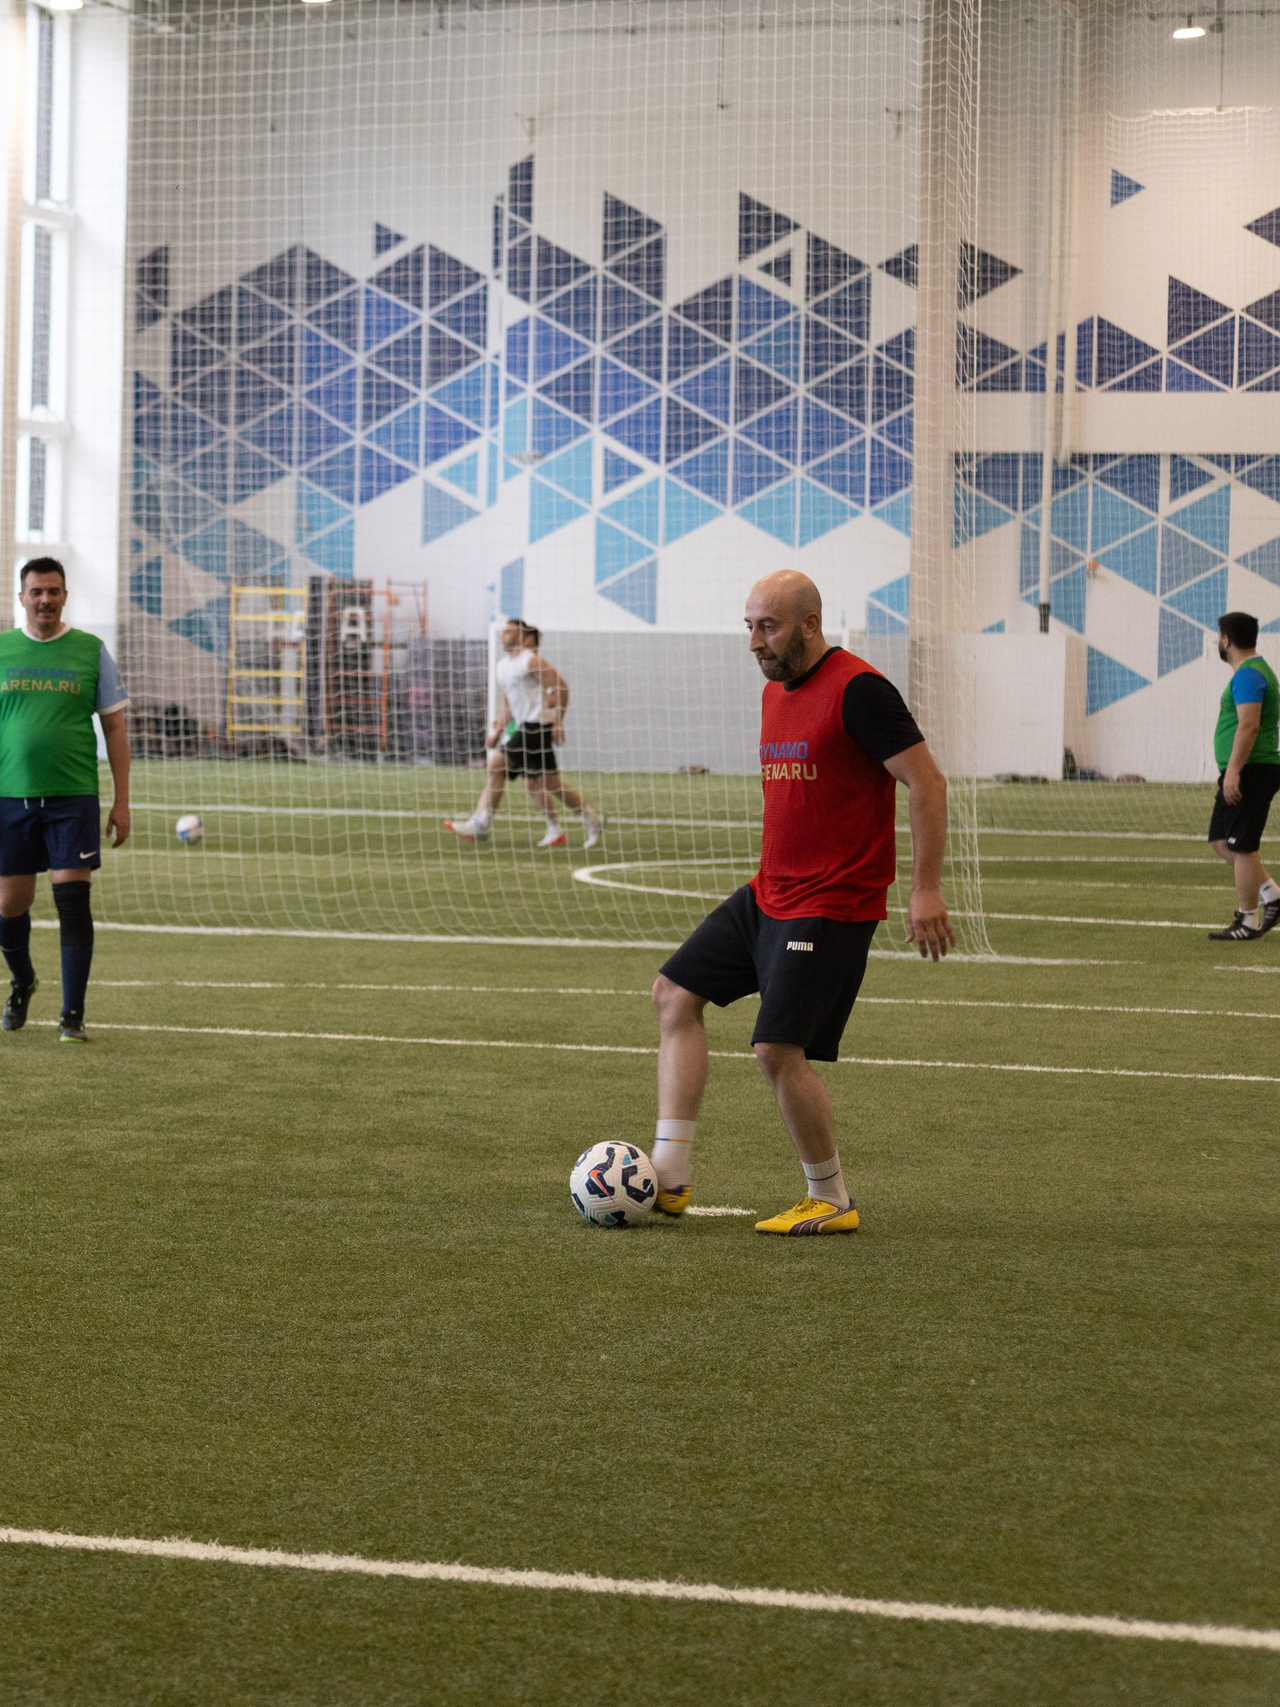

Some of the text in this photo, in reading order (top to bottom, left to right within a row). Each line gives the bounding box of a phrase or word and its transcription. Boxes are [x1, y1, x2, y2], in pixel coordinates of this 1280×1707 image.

[5, 667, 78, 681] DYNAMO
[0, 679, 81, 695] ARENA.RU
[786, 941, 814, 951] PUMA
